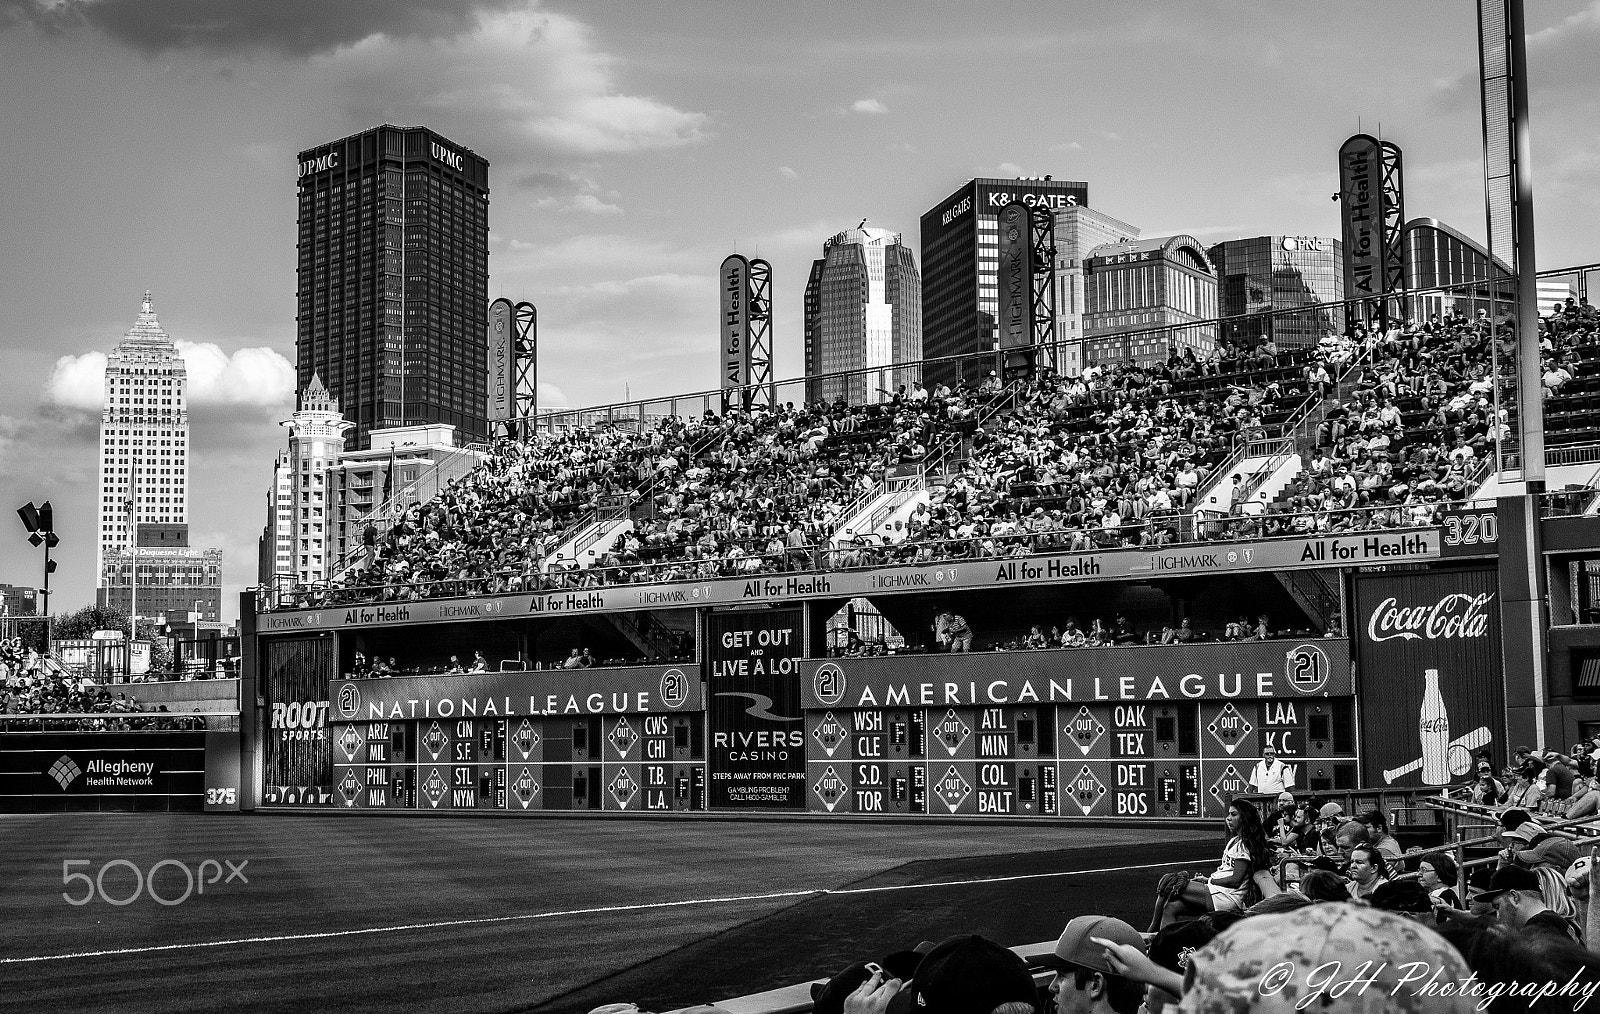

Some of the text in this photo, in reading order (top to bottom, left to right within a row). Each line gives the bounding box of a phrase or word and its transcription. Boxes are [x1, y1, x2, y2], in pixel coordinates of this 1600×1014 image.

[298, 152, 338, 178] UPMC
[431, 141, 463, 172] UPMC
[1022, 194, 1076, 208] GATES
[942, 196, 971, 226] K&L GATES
[1350, 150, 1372, 292] All for Health
[1298, 240, 1323, 252] PNC
[727, 268, 740, 384] All for Health
[1443, 512, 1498, 546] 320
[140, 549, 198, 557] Duquesne Light
[1300, 535, 1428, 562] All for Health
[996, 558, 1100, 581] All for Health
[743, 576, 832, 598] All for Health
[529, 592, 604, 612] All for Health
[344, 606, 410, 624] All for Health
[1368, 592, 1495, 642] Coca-Cola
[722, 629, 792, 648] GET OUT
[713, 658, 801, 676] LIVE A LOT
[1294, 652, 1320, 684] 21
[665, 674, 684, 702] 21
[820, 669, 840, 698] 21
[858, 673, 1274, 705] AMERICAN LEAGUE
[342, 689, 356, 712] 21
[370, 692, 649, 720] NATIONAL LEAGUE
[272, 702, 330, 728] ROOT
[854, 711, 882, 730] WSH
[982, 709, 1007, 729] ATL
[1114, 705, 1146, 727] OAK
[1221, 716, 1238, 728] OUT
[1266, 702, 1298, 725] LAA
[368, 723, 388, 740] ARIZ
[456, 720, 472, 738] CIN
[617, 728, 628, 738] OUT
[645, 716, 668, 734] CWS
[823, 724, 836, 734] OUT
[896, 723, 905, 742] F
[944, 722, 959, 732] OUT
[1076, 720, 1092, 730] OUT
[346, 734, 356, 742] OUT
[430, 732, 440, 741] OUT
[520, 730, 531, 740] OUT
[714, 730, 804, 748] RIVERS
[1117, 734, 1144, 754] TEX
[1266, 732, 1297, 754] K.C.
[370, 744, 386, 761] MIL
[456, 743, 471, 760] S.F.
[648, 740, 666, 758] CHI
[858, 736, 880, 756] CLE
[982, 735, 1008, 756] MIN
[729, 751, 788, 761] CASINO
[86, 759, 154, 776] Allegheny
[367, 768, 388, 784] PHIL
[456, 768, 472, 784] STL
[648, 766, 666, 785] T.B.
[712, 772, 806, 780] STEPS AWAY FROM PNC PARK
[859, 765, 882, 785] S.D.
[982, 764, 1008, 785] COL
[1118, 764, 1146, 786] DET
[86, 776, 153, 786] Health Network
[346, 780, 355, 788] OUT
[430, 780, 440, 788] OUT
[520, 779, 531, 788] OUT
[618, 779, 629, 788] OUT
[728, 786, 758, 794] GAMBLING
[824, 779, 837, 789] OUT
[896, 778, 906, 798] F
[946, 779, 960, 790] OUT
[1078, 780, 1094, 790] OUT
[1164, 779, 1176, 801] F
[1223, 780, 1240, 791] OUT
[206, 788, 236, 805] 375
[370, 790, 386, 806] MIA
[454, 790, 474, 807] NYM
[648, 790, 668, 809] L.A.
[856, 791, 882, 811] TOR
[978, 792, 1012, 812] BALT
[1117, 792, 1148, 814] BOS
